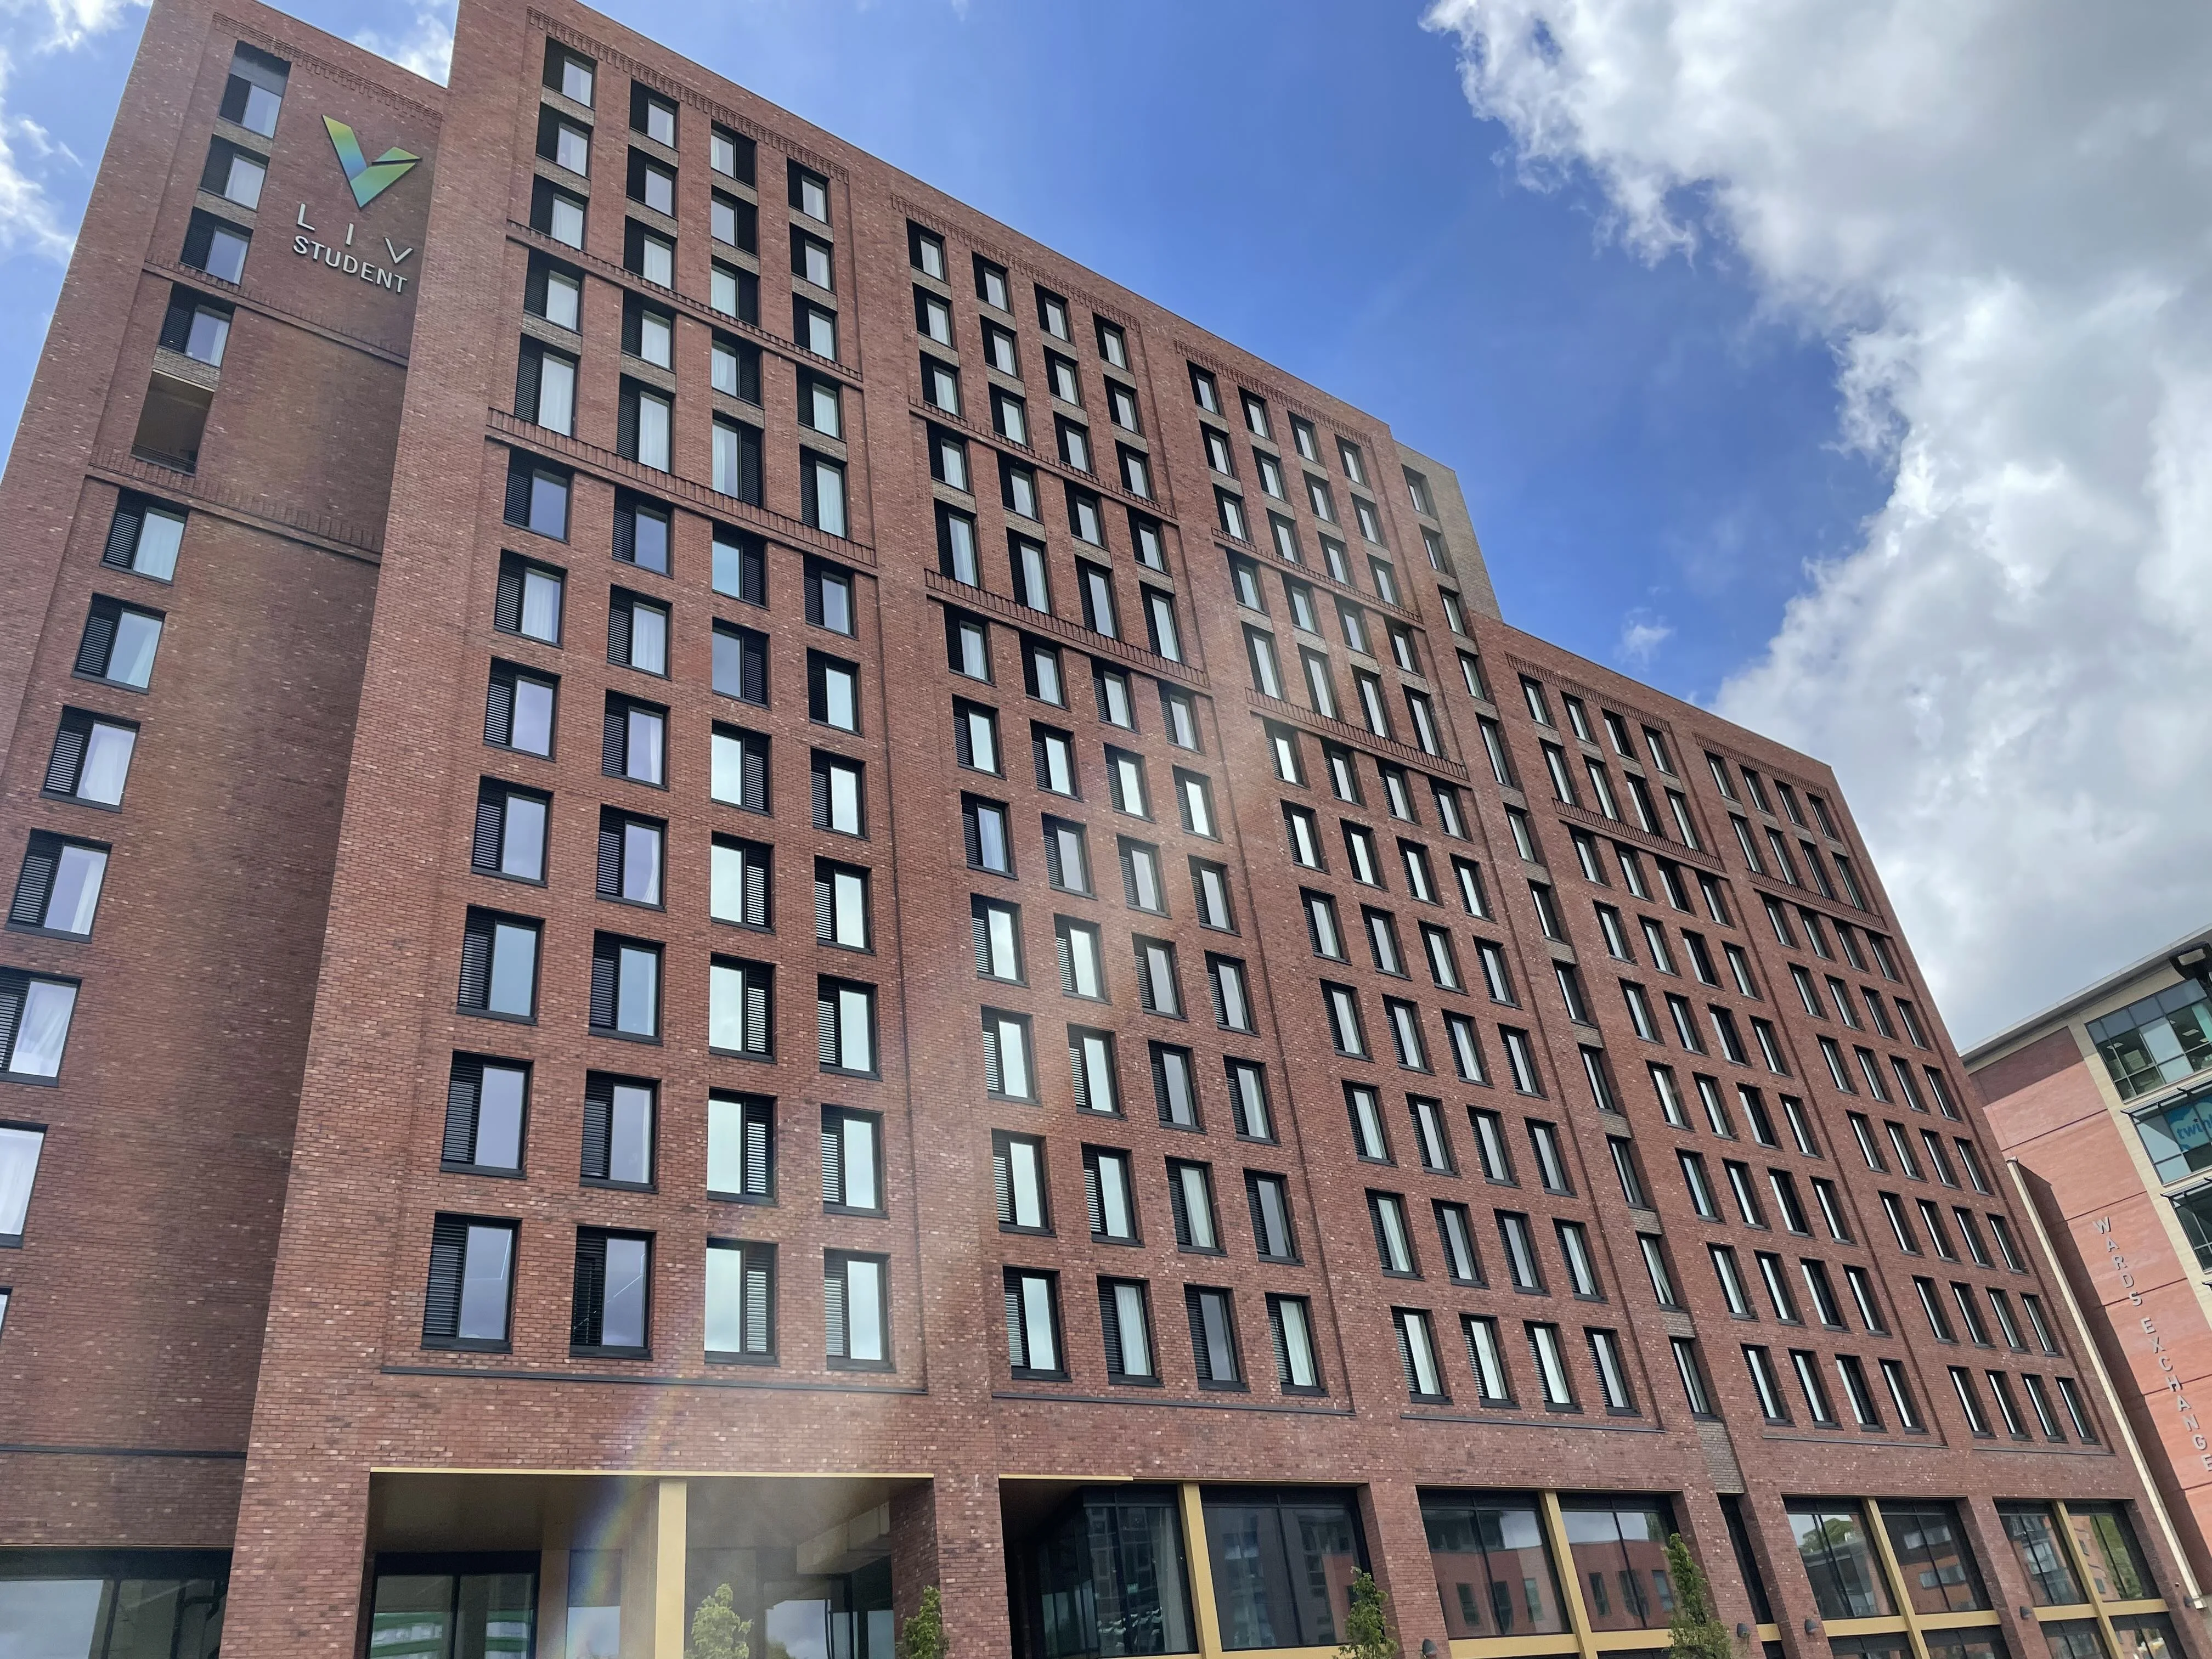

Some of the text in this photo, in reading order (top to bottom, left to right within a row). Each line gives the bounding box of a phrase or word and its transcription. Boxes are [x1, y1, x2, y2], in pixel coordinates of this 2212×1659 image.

[297, 203, 413, 264] LIV
[293, 235, 408, 294] STUDENT
[2092, 1216, 2142, 1307] WARDS
